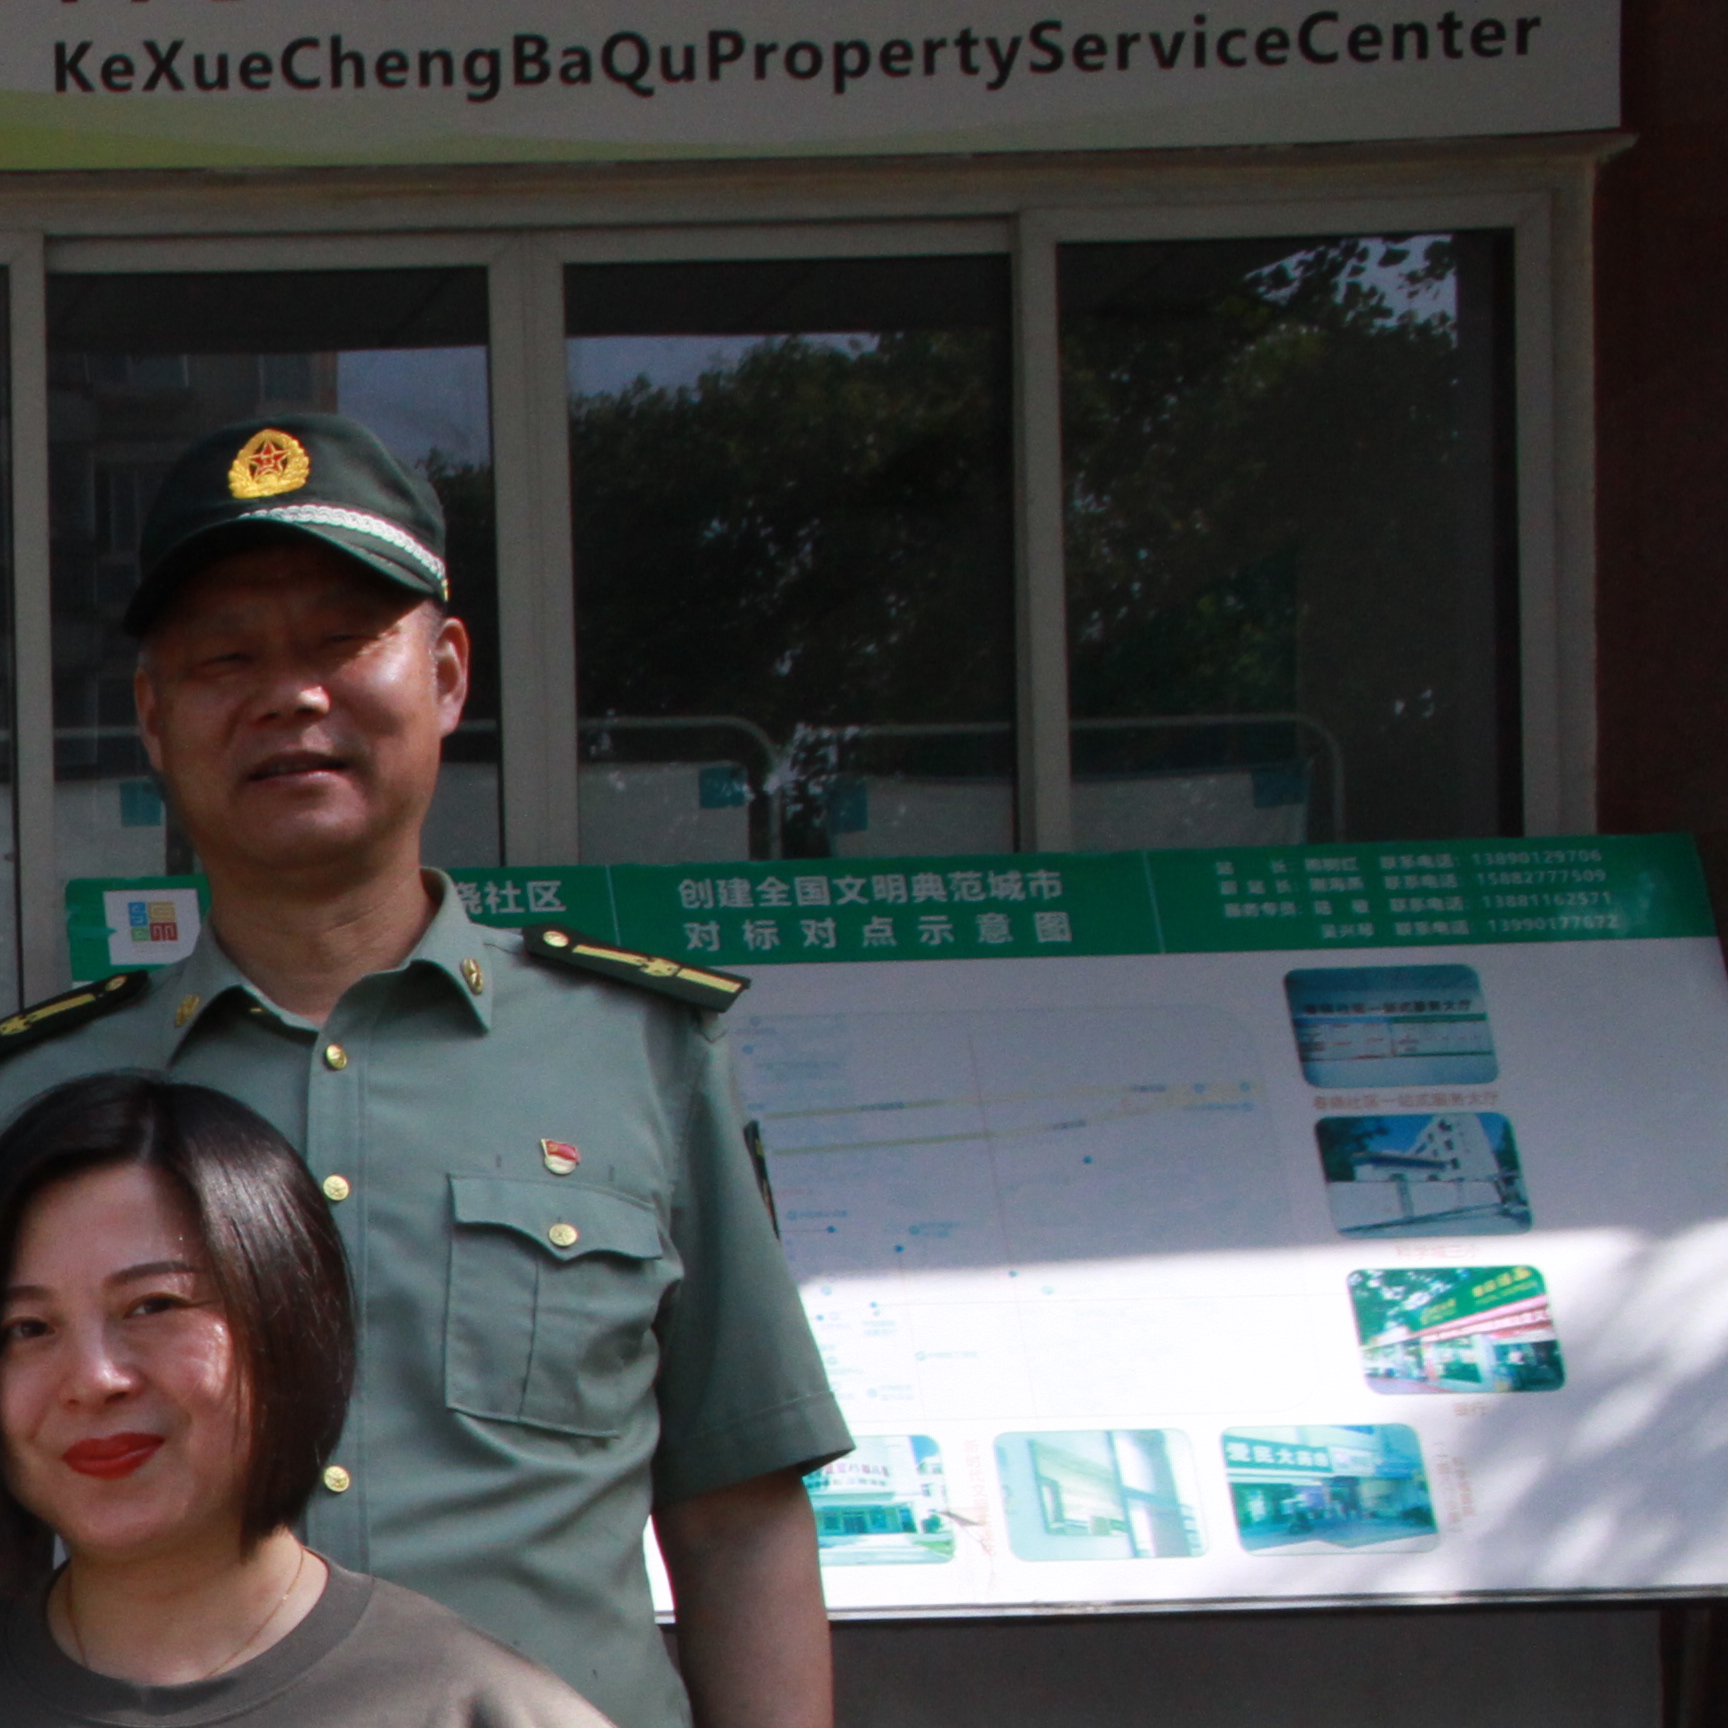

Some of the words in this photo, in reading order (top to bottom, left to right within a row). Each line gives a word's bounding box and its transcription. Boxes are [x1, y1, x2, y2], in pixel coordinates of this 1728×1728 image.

[53, 10, 1542, 102] KeXueChengBaQuPropertyServiceCenter
[678, 869, 1064, 910] 创建全国文明典范城市
[684, 912, 1073, 952] 对标对点示意图
